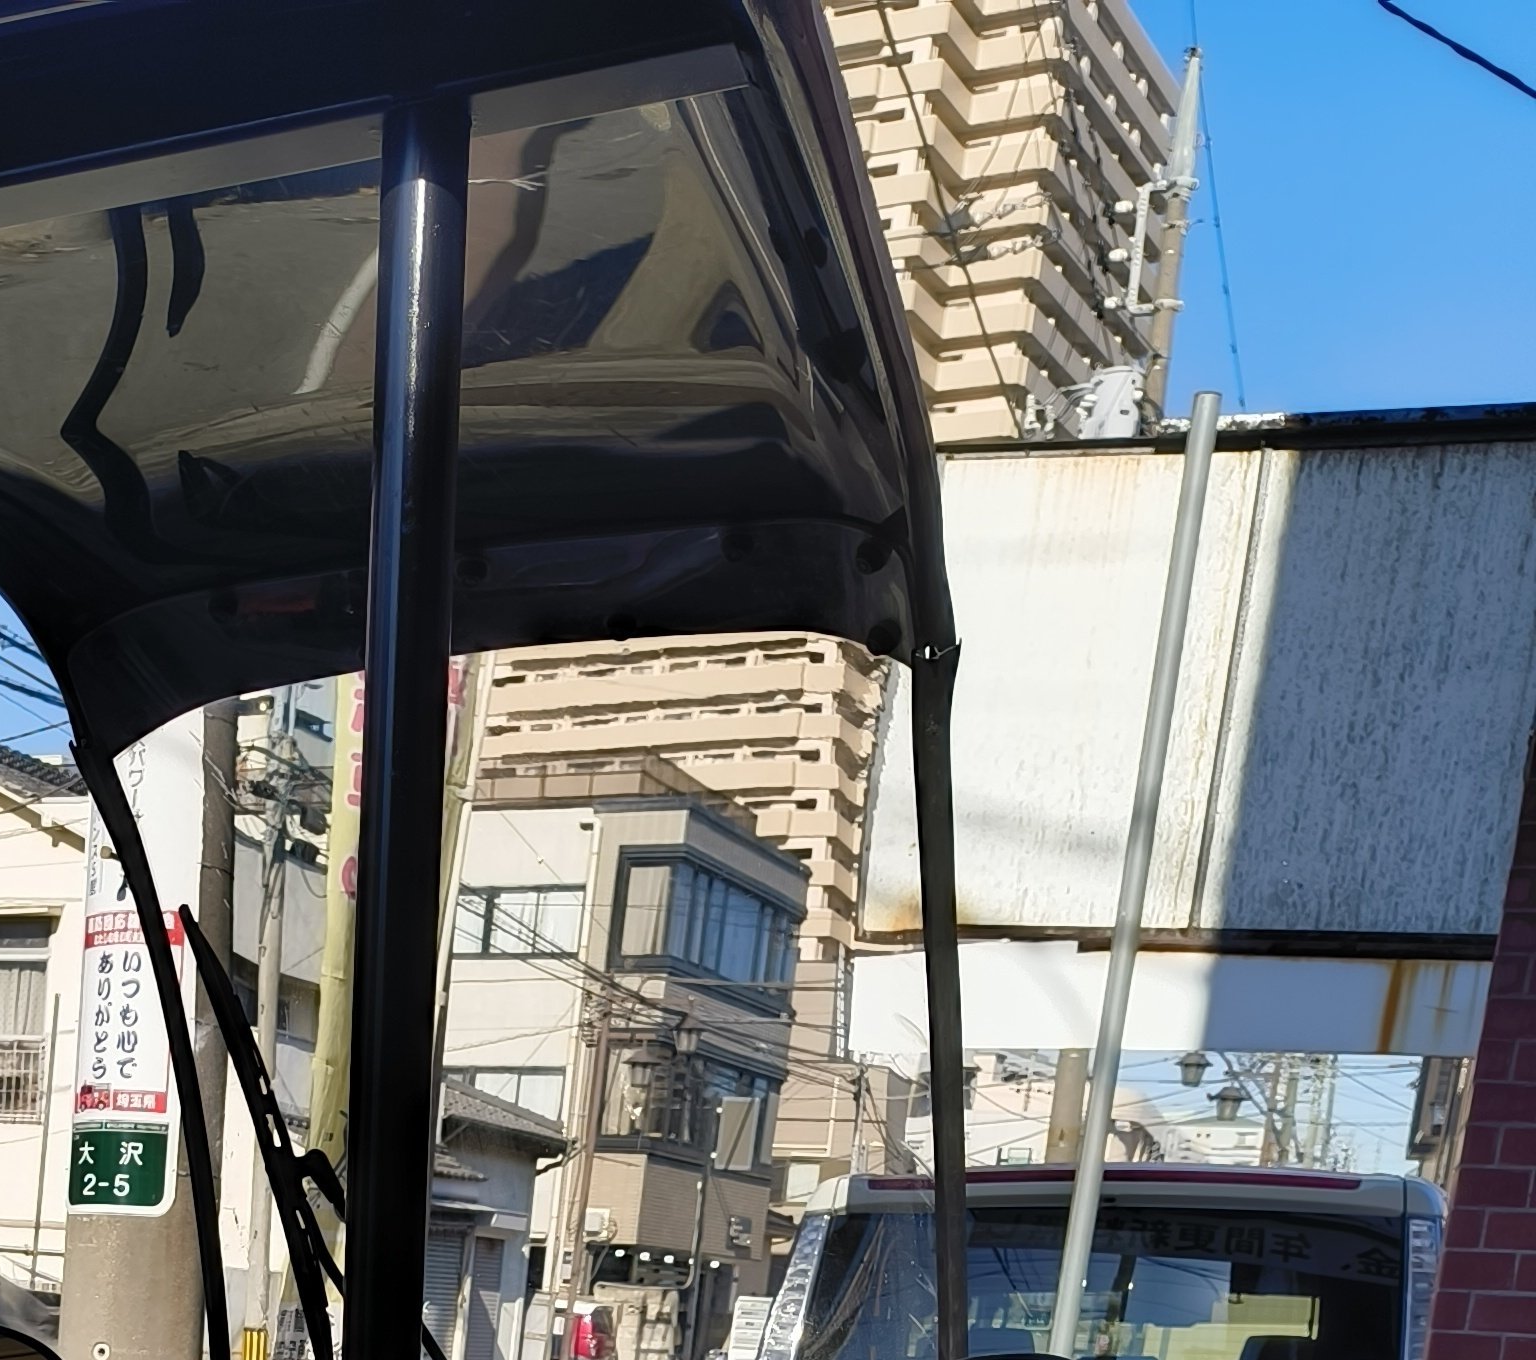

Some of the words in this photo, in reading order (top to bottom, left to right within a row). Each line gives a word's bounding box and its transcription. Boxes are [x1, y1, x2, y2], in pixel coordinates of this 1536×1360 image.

[91, 950, 114, 1080] ありがとう
[116, 950, 142, 1079] いつも心で
[116, 1093, 156, 1110] 埼玉県
[78, 1141, 144, 1166] 大沢
[82, 1173, 130, 1196] 2-5
